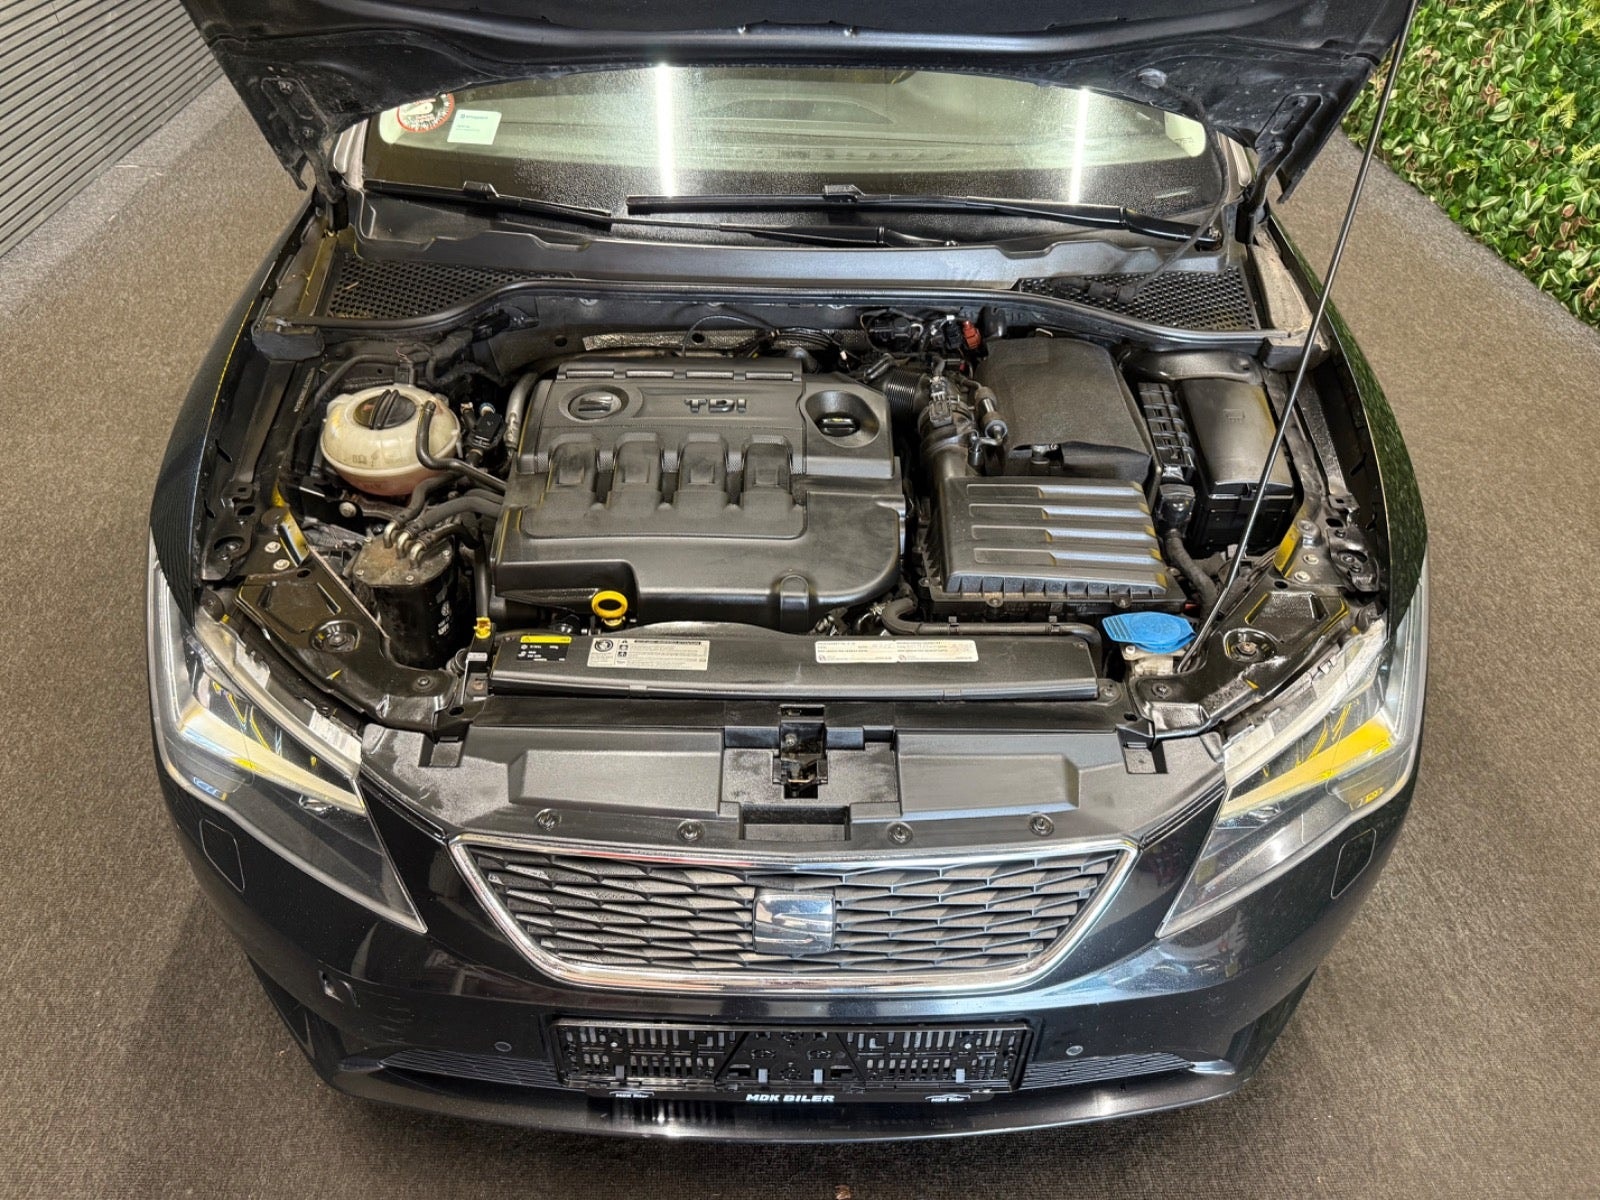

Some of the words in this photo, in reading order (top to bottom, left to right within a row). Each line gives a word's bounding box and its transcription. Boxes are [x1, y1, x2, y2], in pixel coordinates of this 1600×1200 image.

[684, 398, 747, 413] TDI
[745, 1094, 780, 1102] MDK
[783, 1094, 835, 1102] BILER
